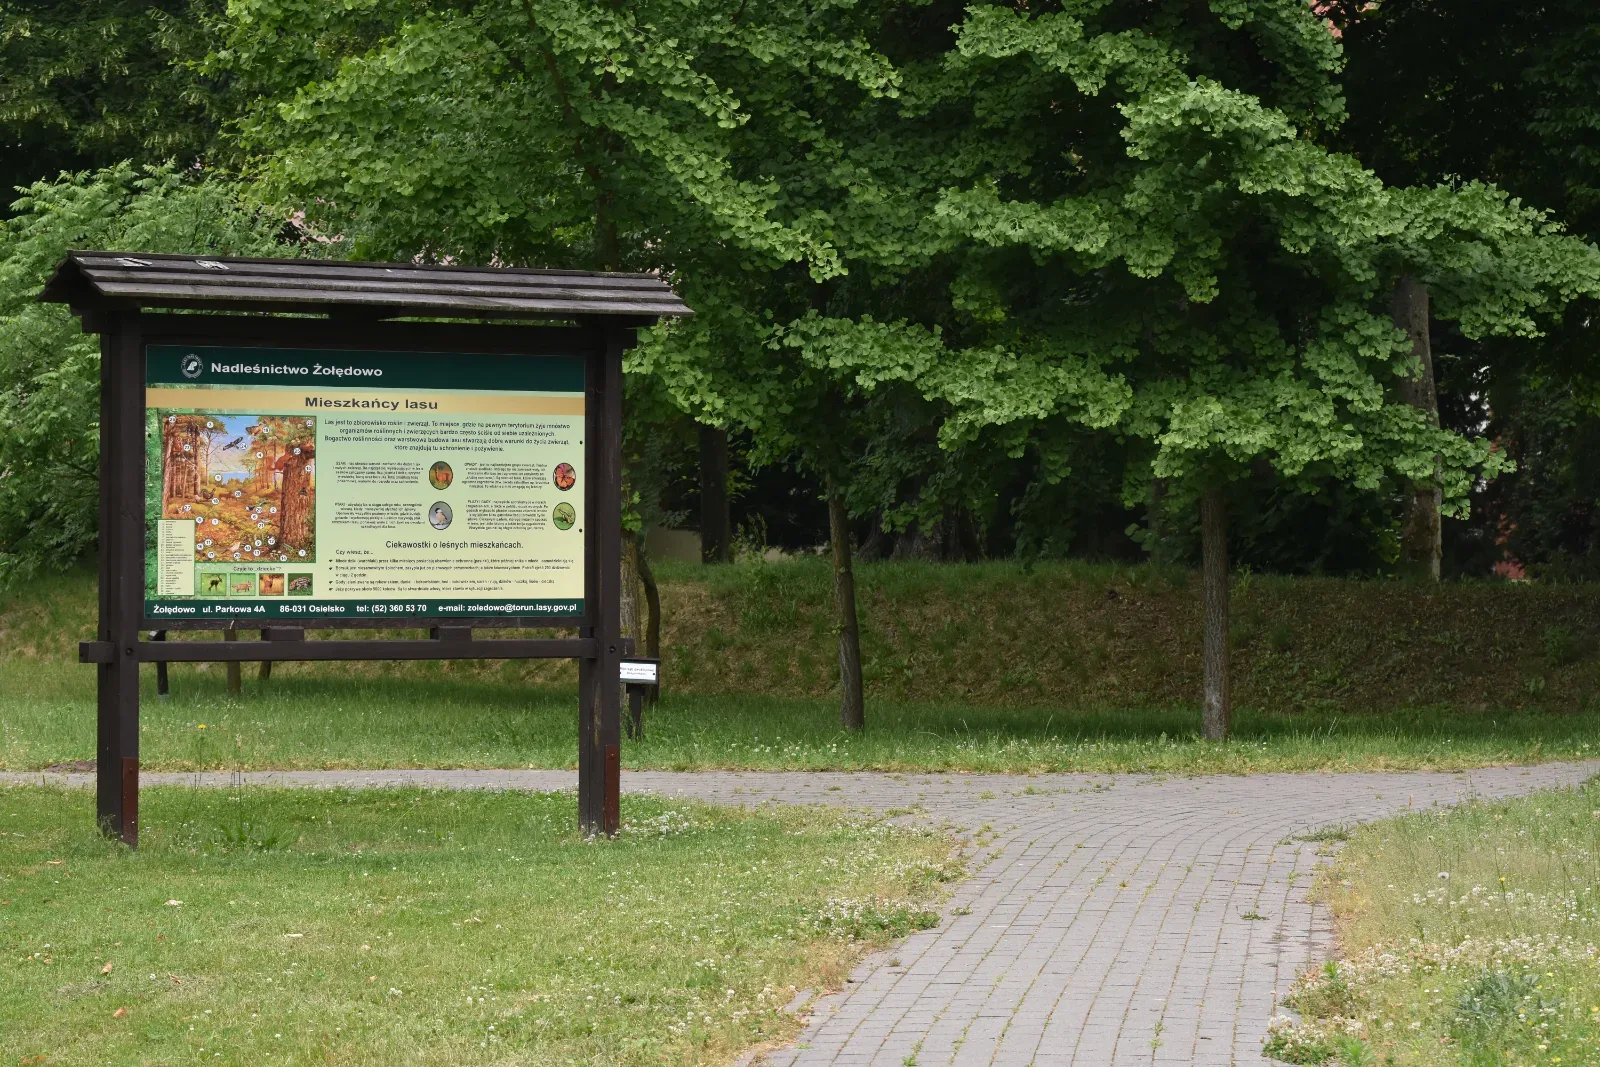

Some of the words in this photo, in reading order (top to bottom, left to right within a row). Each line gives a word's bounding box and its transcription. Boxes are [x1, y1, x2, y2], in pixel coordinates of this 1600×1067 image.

[211, 363, 309, 375] Nadleśnictwo
[313, 364, 382, 377] Żołędowo
[305, 397, 399, 410] Mieszkańcy
[406, 399, 437, 409] lasu
[440, 541, 468, 550] leśnych
[154, 604, 195, 614] Żołędowo
[372, 605, 387, 613] (52)
[468, 604, 576, 612] zoledowo@torun.lasy.gov.pl
